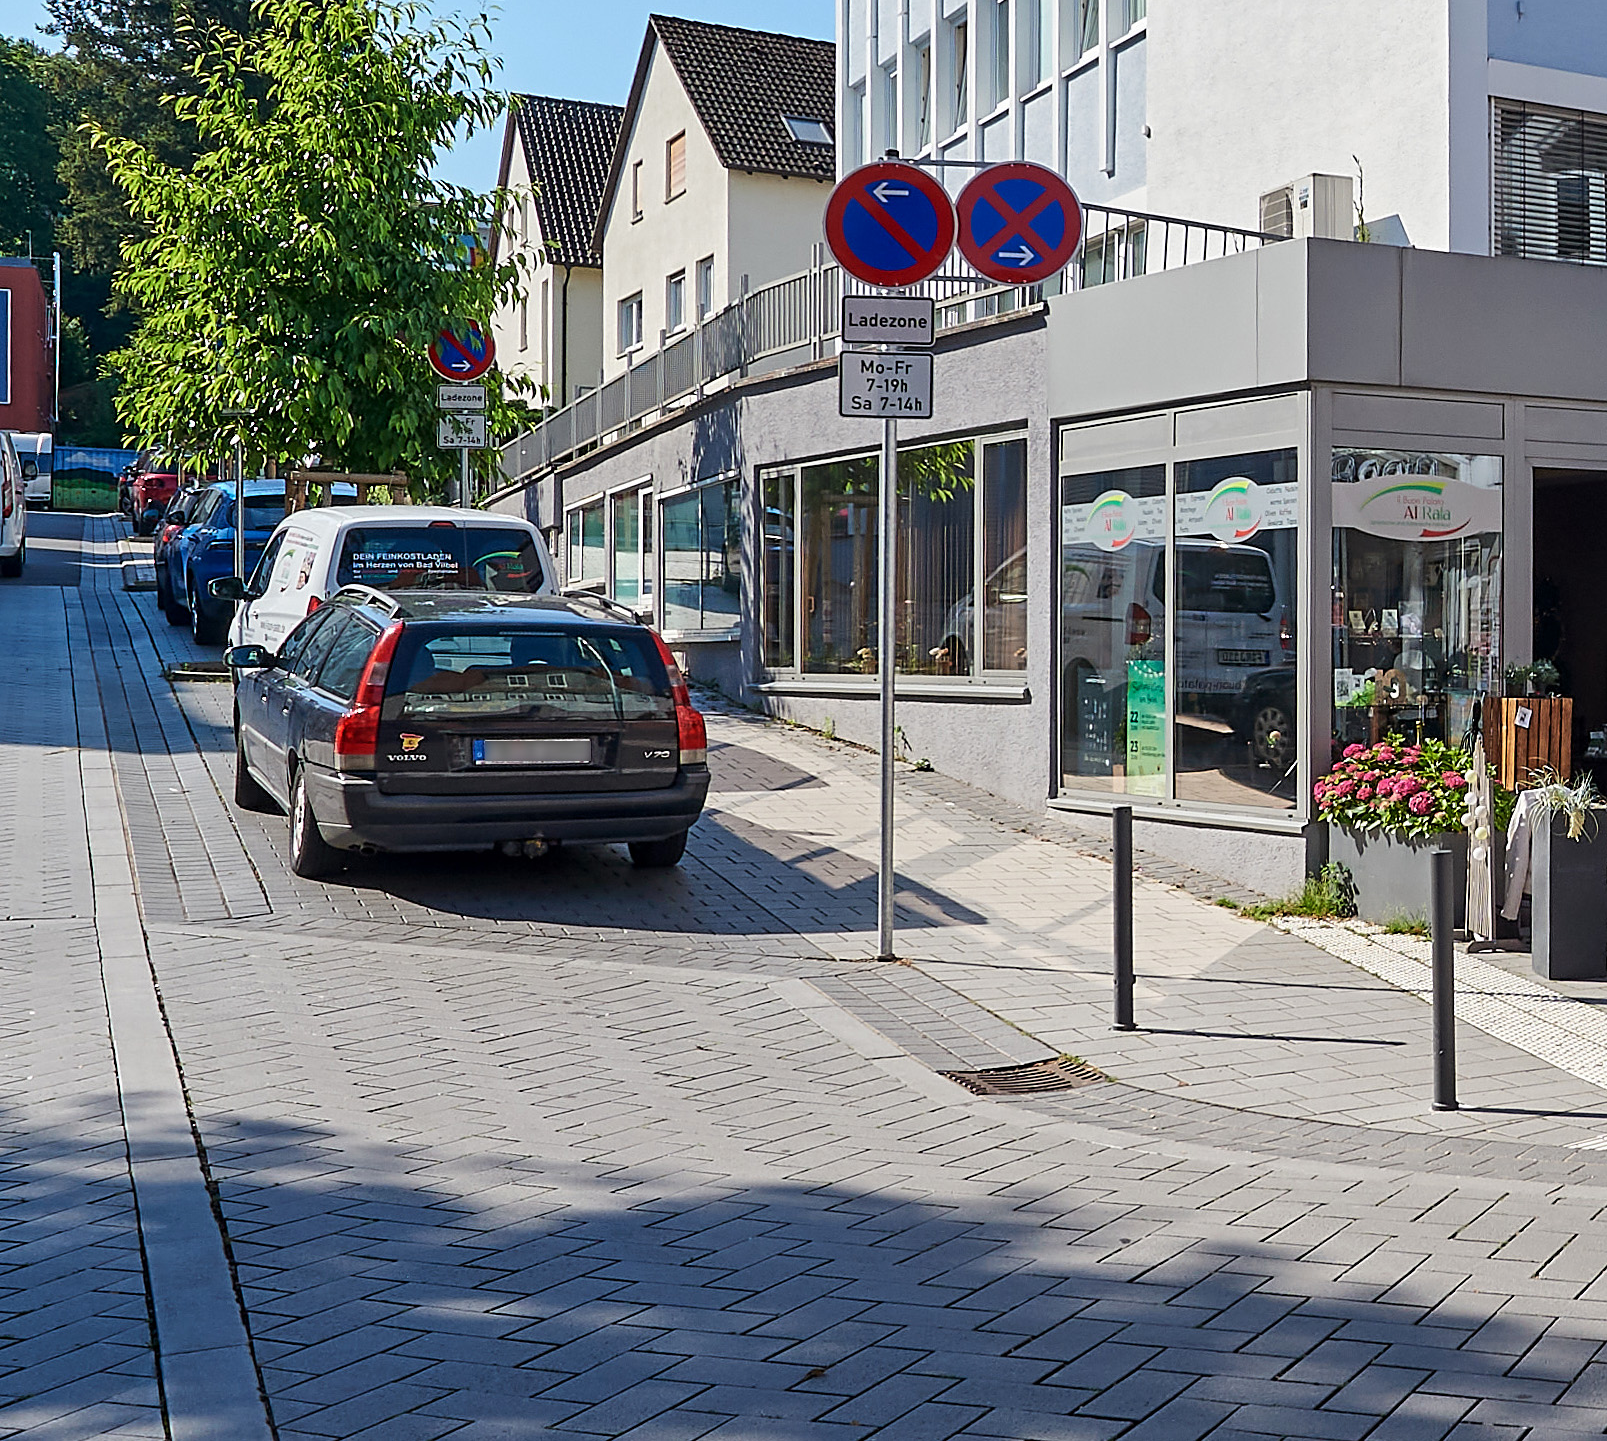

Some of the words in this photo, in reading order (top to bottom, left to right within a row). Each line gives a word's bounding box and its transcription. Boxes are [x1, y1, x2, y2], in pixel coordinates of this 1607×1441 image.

[848, 312, 928, 328] Ladezone
[860, 359, 913, 374] Mo-Fr
[866, 378, 908, 392] 7-19h
[441, 393, 483, 402] Ladezone
[851, 395, 872, 410] Sa
[880, 396, 922, 411] 7-14h
[376, 553, 451, 561] FEINKOSTLADEN
[1130, 711, 1139, 723] 22
[1130, 741, 1139, 752] 23
